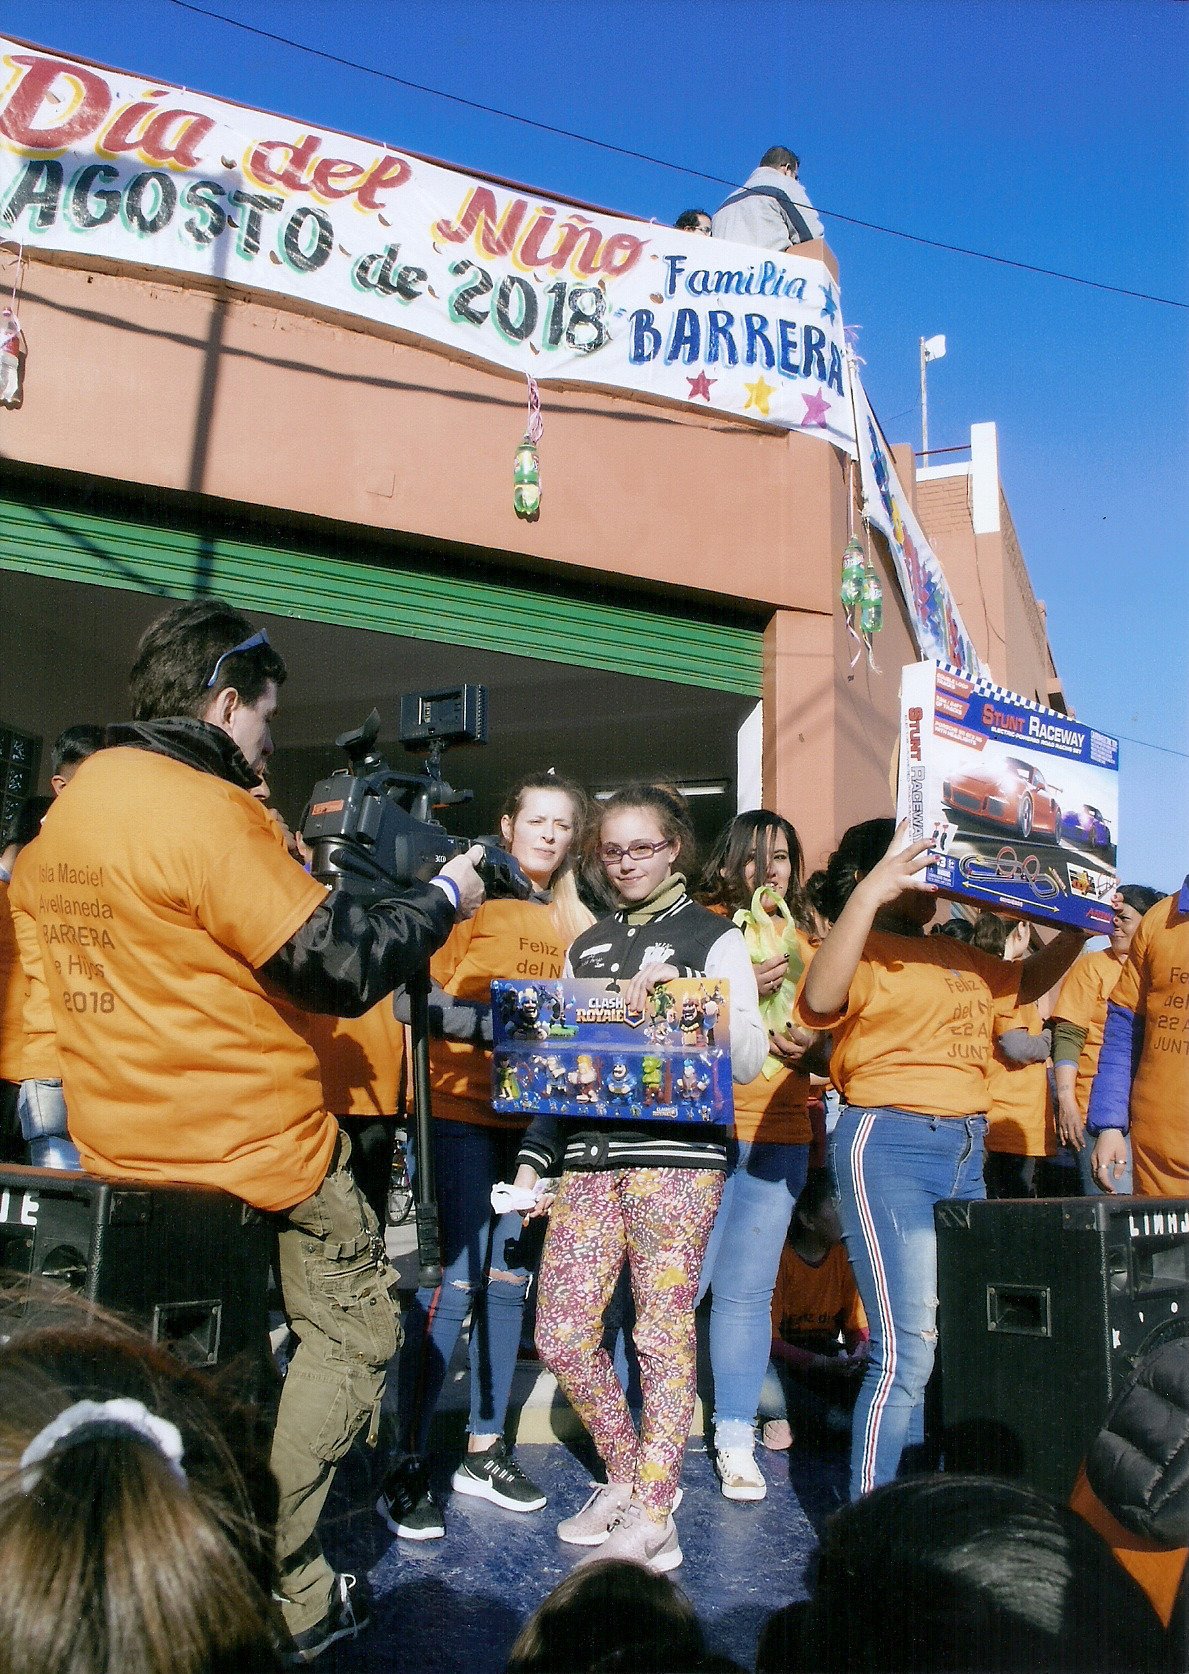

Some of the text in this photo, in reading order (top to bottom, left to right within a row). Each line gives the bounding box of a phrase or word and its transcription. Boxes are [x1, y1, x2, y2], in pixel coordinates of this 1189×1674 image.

[0, 54, 649, 281] Día del Niño
[0, 159, 610, 354] AGOSTO de 2018
[664, 254, 808, 301] Familia
[628, 308, 846, 398] BARRERA
[908, 706, 923, 762] STUNT
[982, 703, 1025, 734] STUNT
[1028, 715, 1085, 748] RACEWAY
[39, 863, 104, 888] Isla Maciel
[38, 894, 114, 919] Avellaneda
[43, 924, 116, 950] BARRERA
[519, 937, 559, 957] Feliz
[69, 954, 105, 980] Hijos
[516, 959, 544, 977] del
[944, 977, 981, 994] Feliz
[63, 991, 115, 1014] 2018
[588, 997, 624, 1009] CLASH
[952, 1001, 974, 1020] del
[575, 1008, 625, 1024] ROYALE
[1158, 1014, 1180, 1031] 22
